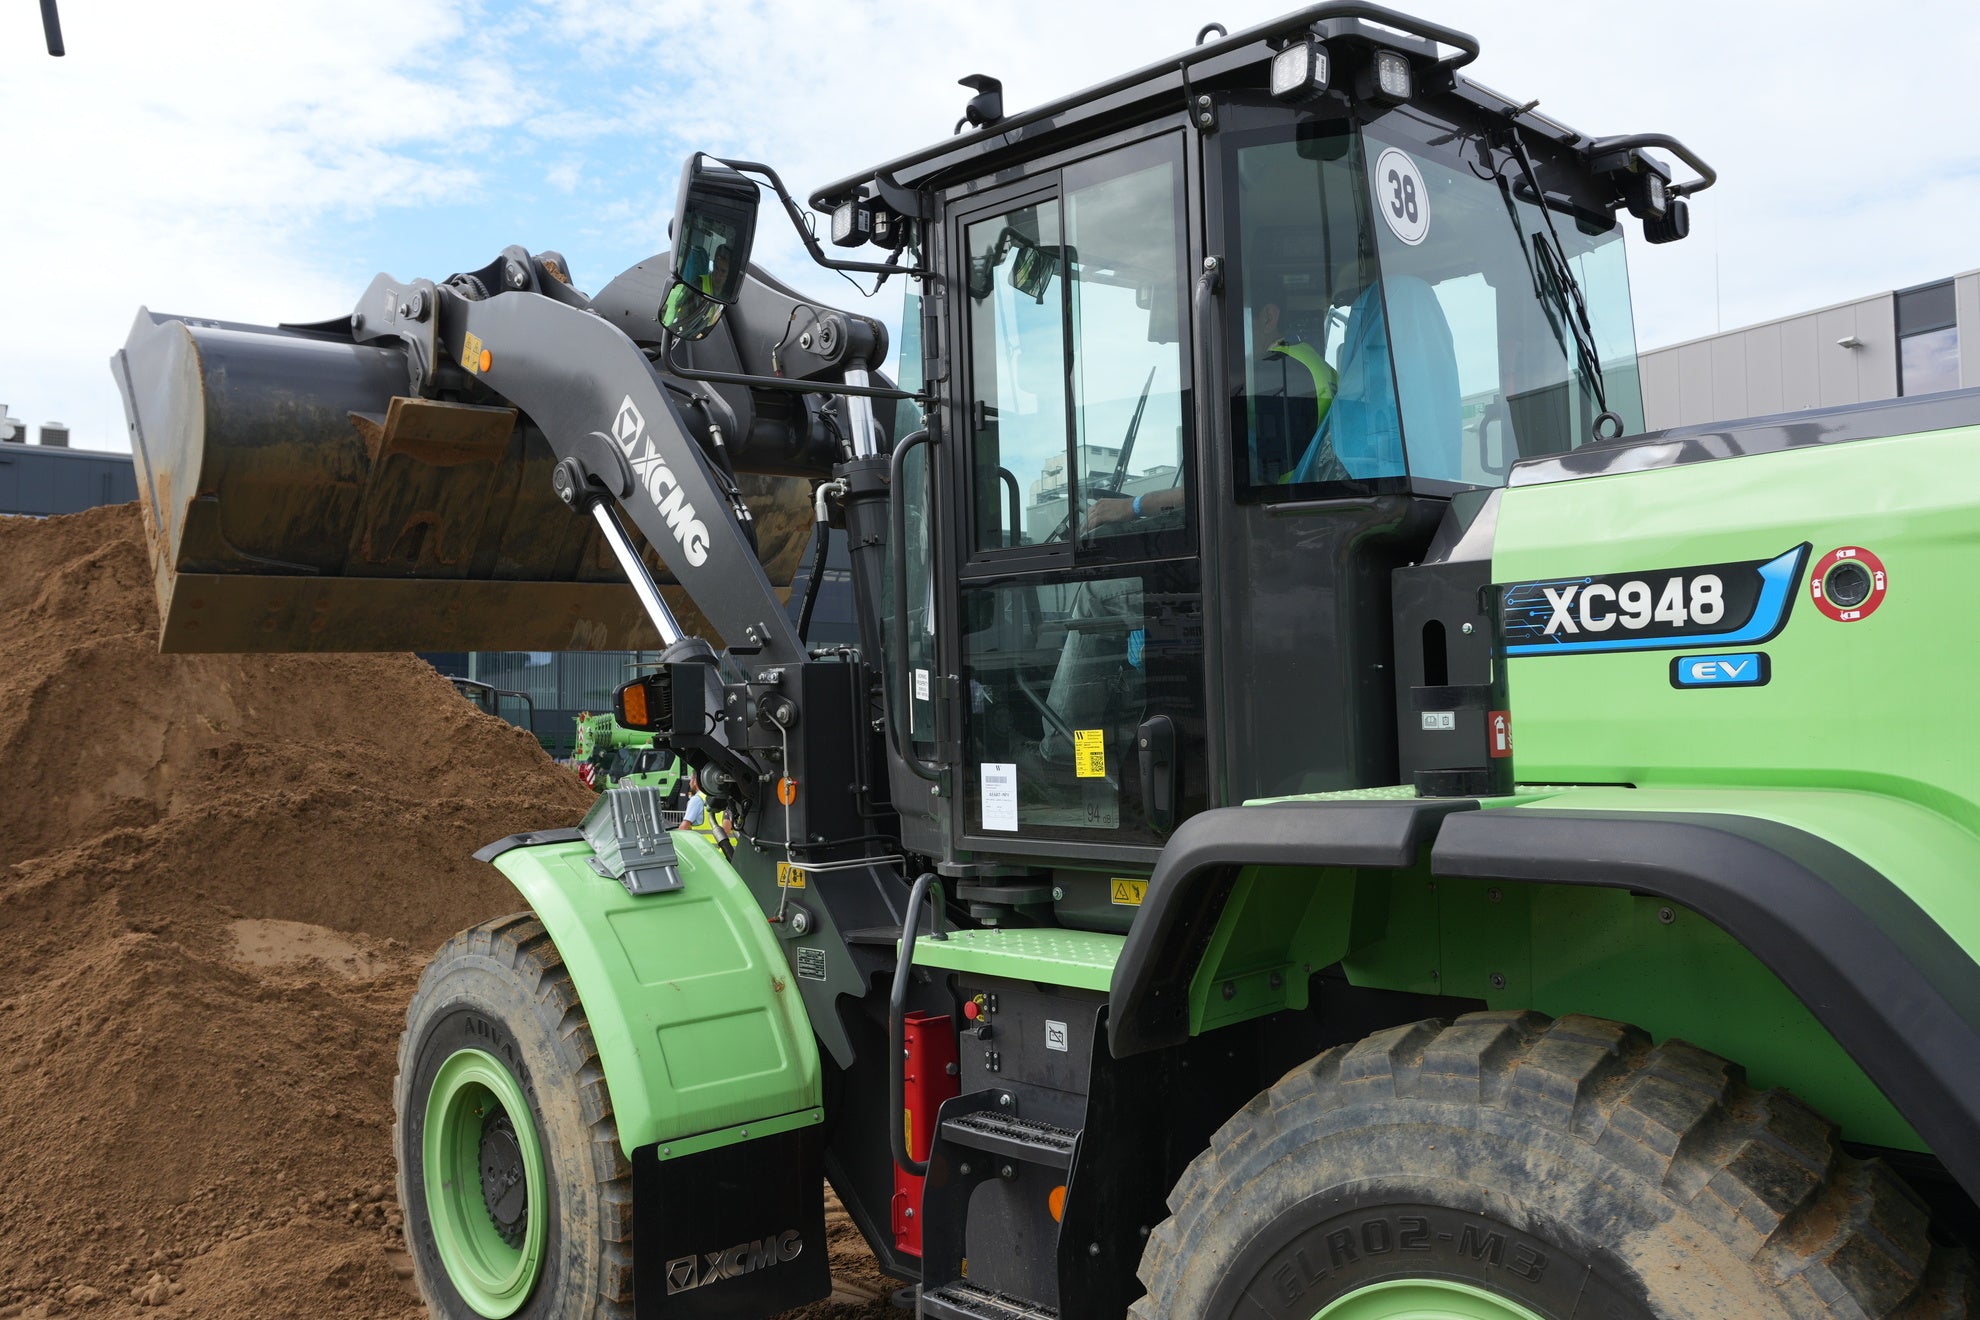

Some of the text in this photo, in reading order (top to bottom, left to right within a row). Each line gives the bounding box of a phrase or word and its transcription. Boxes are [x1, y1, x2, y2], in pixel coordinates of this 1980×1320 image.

[1388, 168, 1419, 224] 38
[629, 434, 710, 568] XCMG
[1542, 573, 1726, 636] XC948
[1691, 659, 1749, 680] EV
[1087, 802, 1100, 823] 94
[699, 1228, 803, 1288] XCMG
